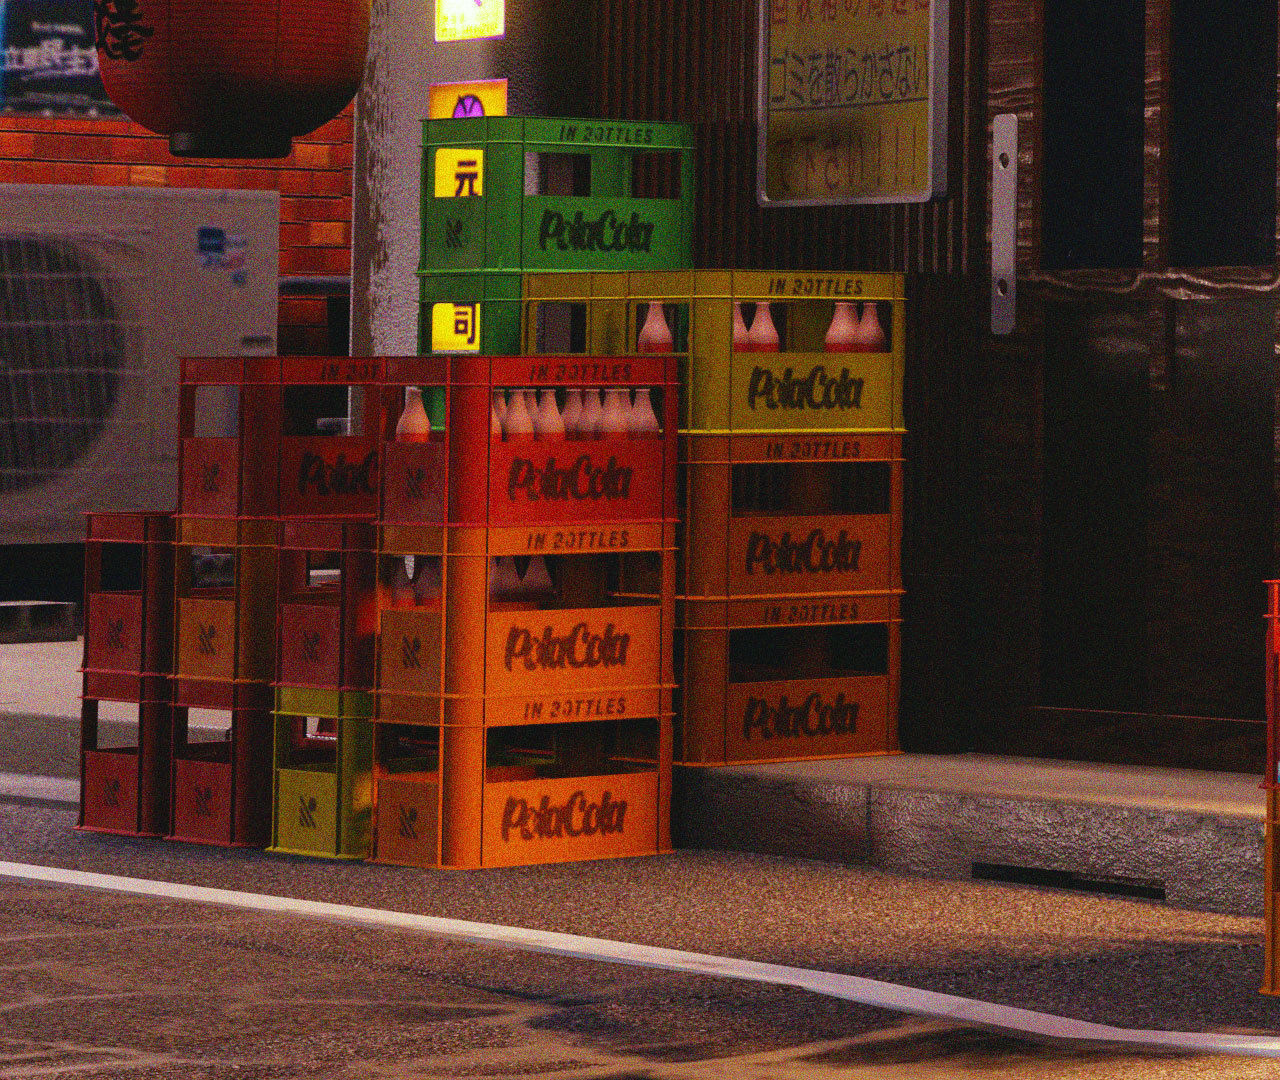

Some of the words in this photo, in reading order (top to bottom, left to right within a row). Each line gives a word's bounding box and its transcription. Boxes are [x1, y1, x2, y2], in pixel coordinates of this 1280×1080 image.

[559, 124, 577, 142] IN
[768, 278, 786, 296] IN
[529, 363, 548, 382] IN
[766, 442, 783, 459] IN
[526, 532, 545, 551] IN
[764, 605, 782, 624] IN
[523, 700, 542, 719] IN
